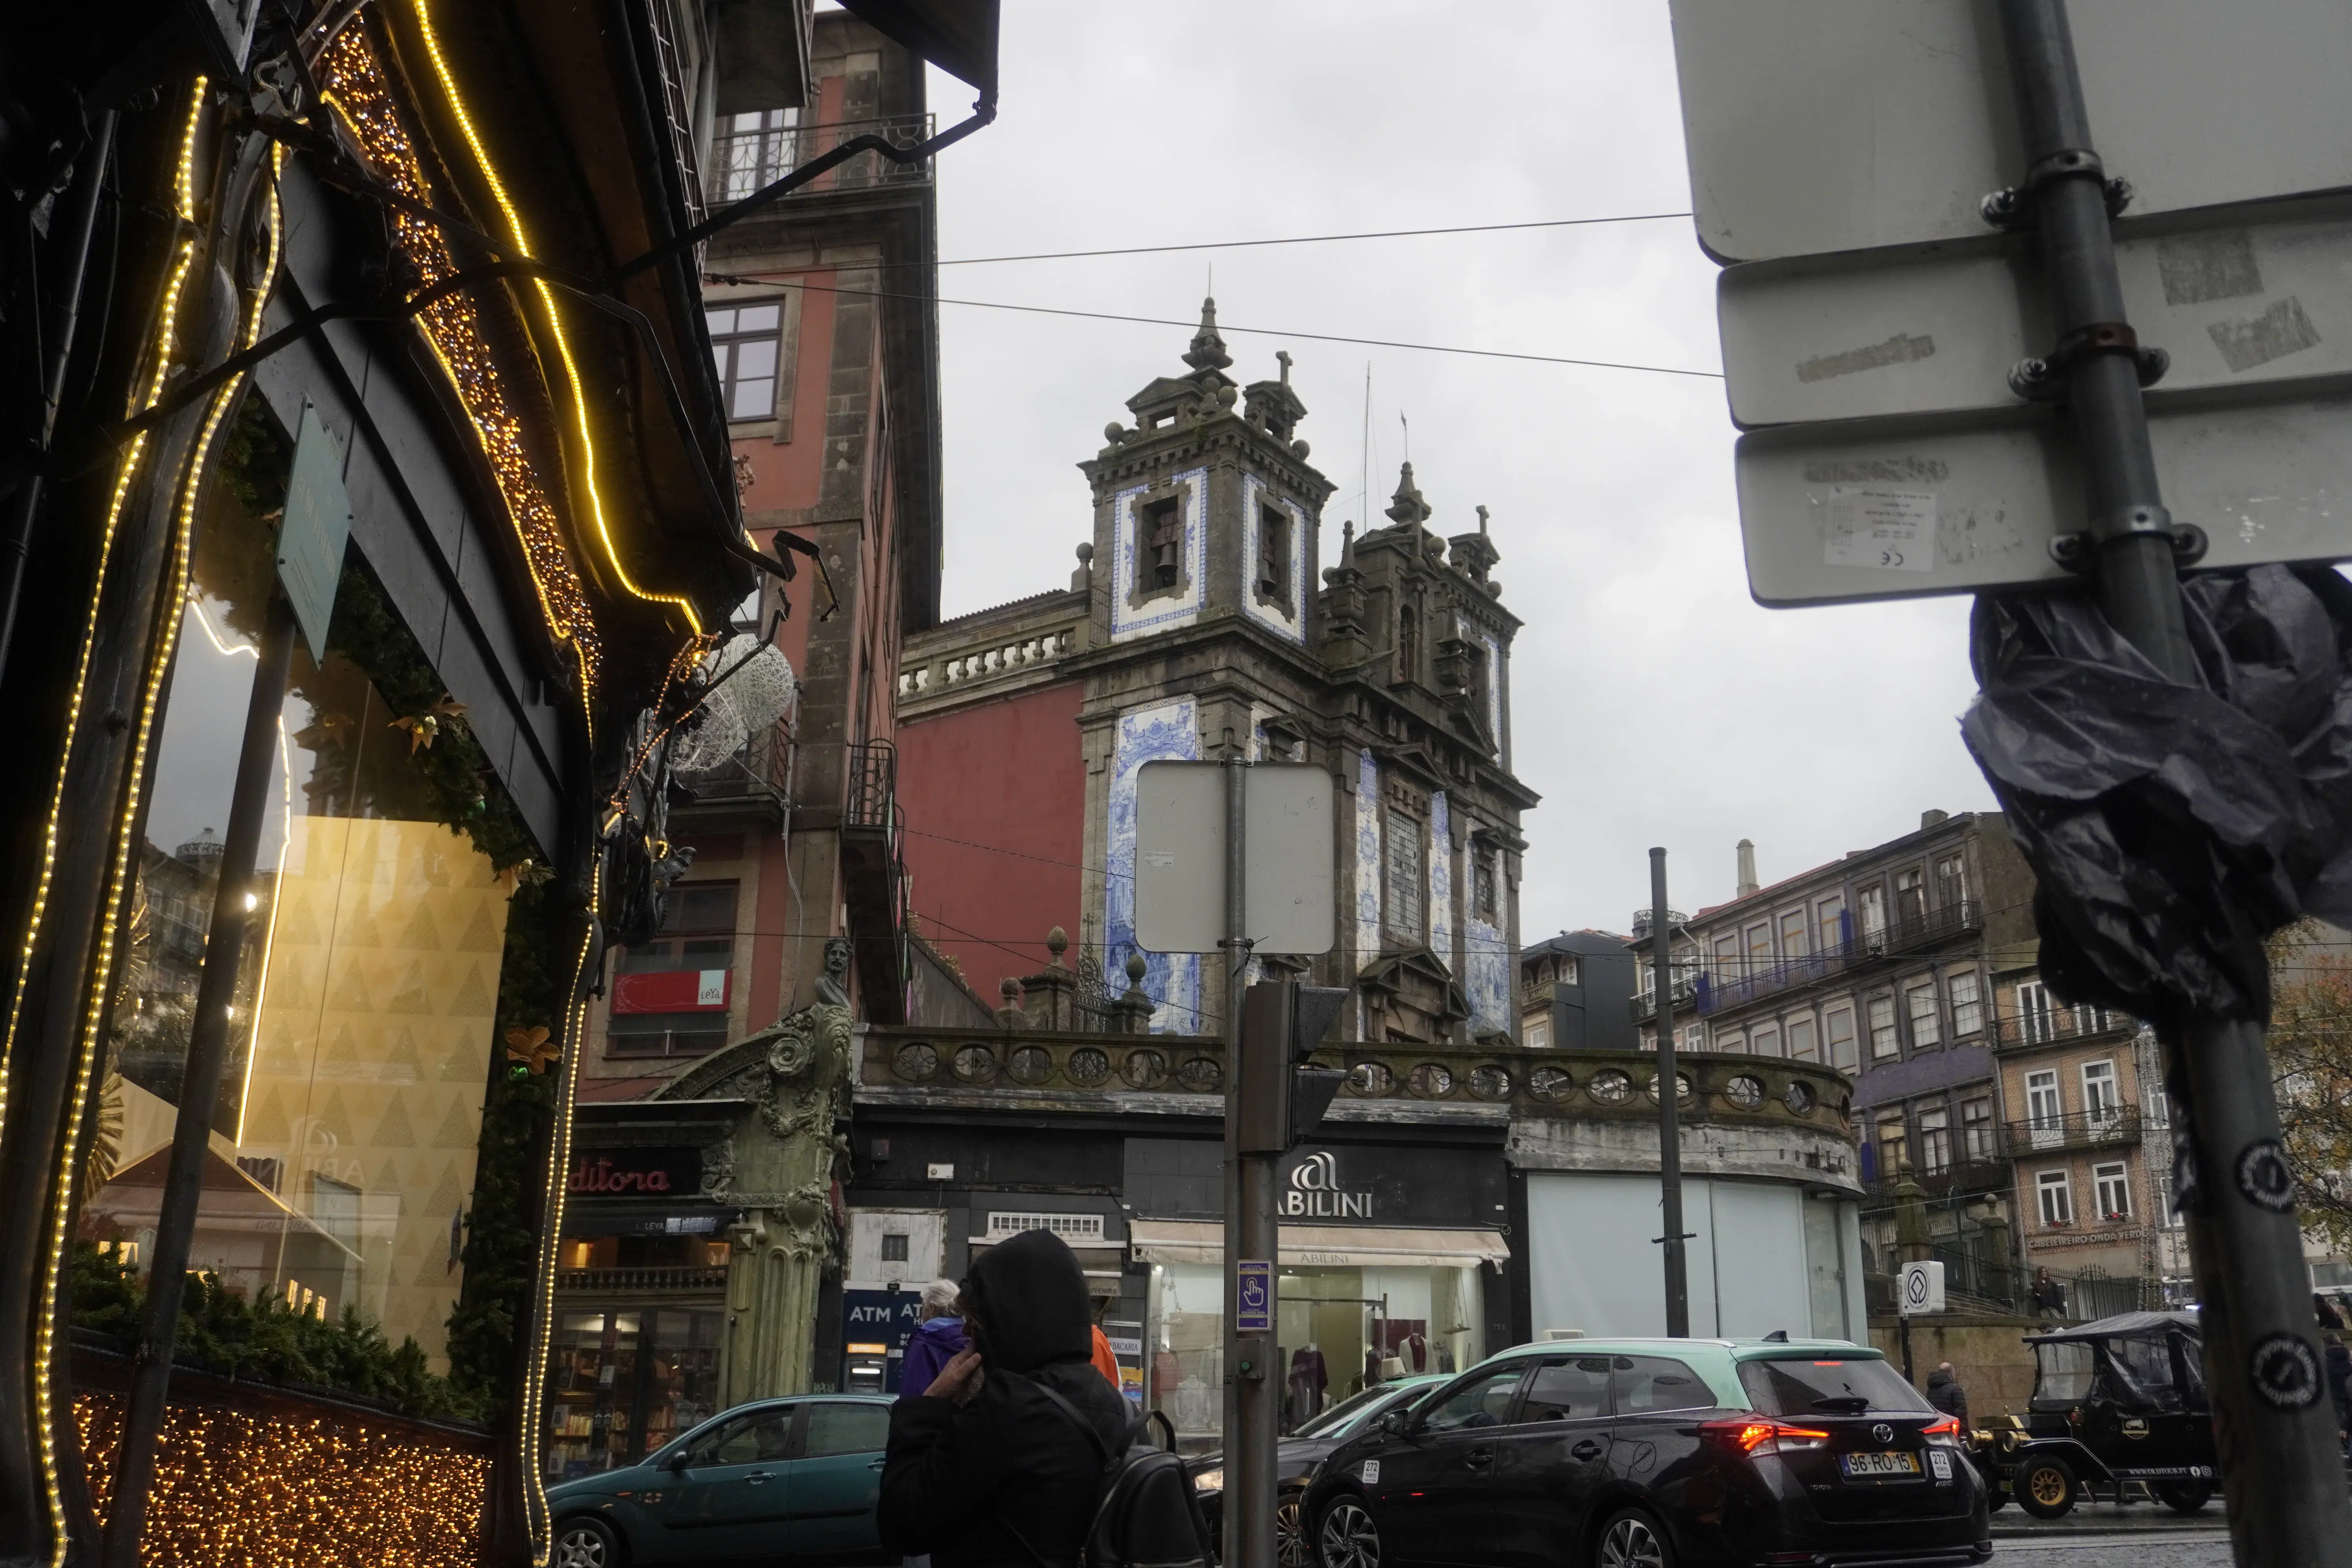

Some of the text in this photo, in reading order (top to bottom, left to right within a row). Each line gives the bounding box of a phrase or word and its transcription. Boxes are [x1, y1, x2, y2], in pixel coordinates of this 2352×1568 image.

[2029, 1235, 2088, 1249] CABELEIREIRO
[2090, 1232, 2117, 1243] ONDA
[1301, 1253, 1350, 1264] ABILINI
[849, 1306, 891, 1322] ATM
[1932, 1453, 1947, 1465] 272
[1366, 1462, 1378, 1472] 272
[2128, 1467, 2188, 1475] WWW.OLDTOUR.PT
